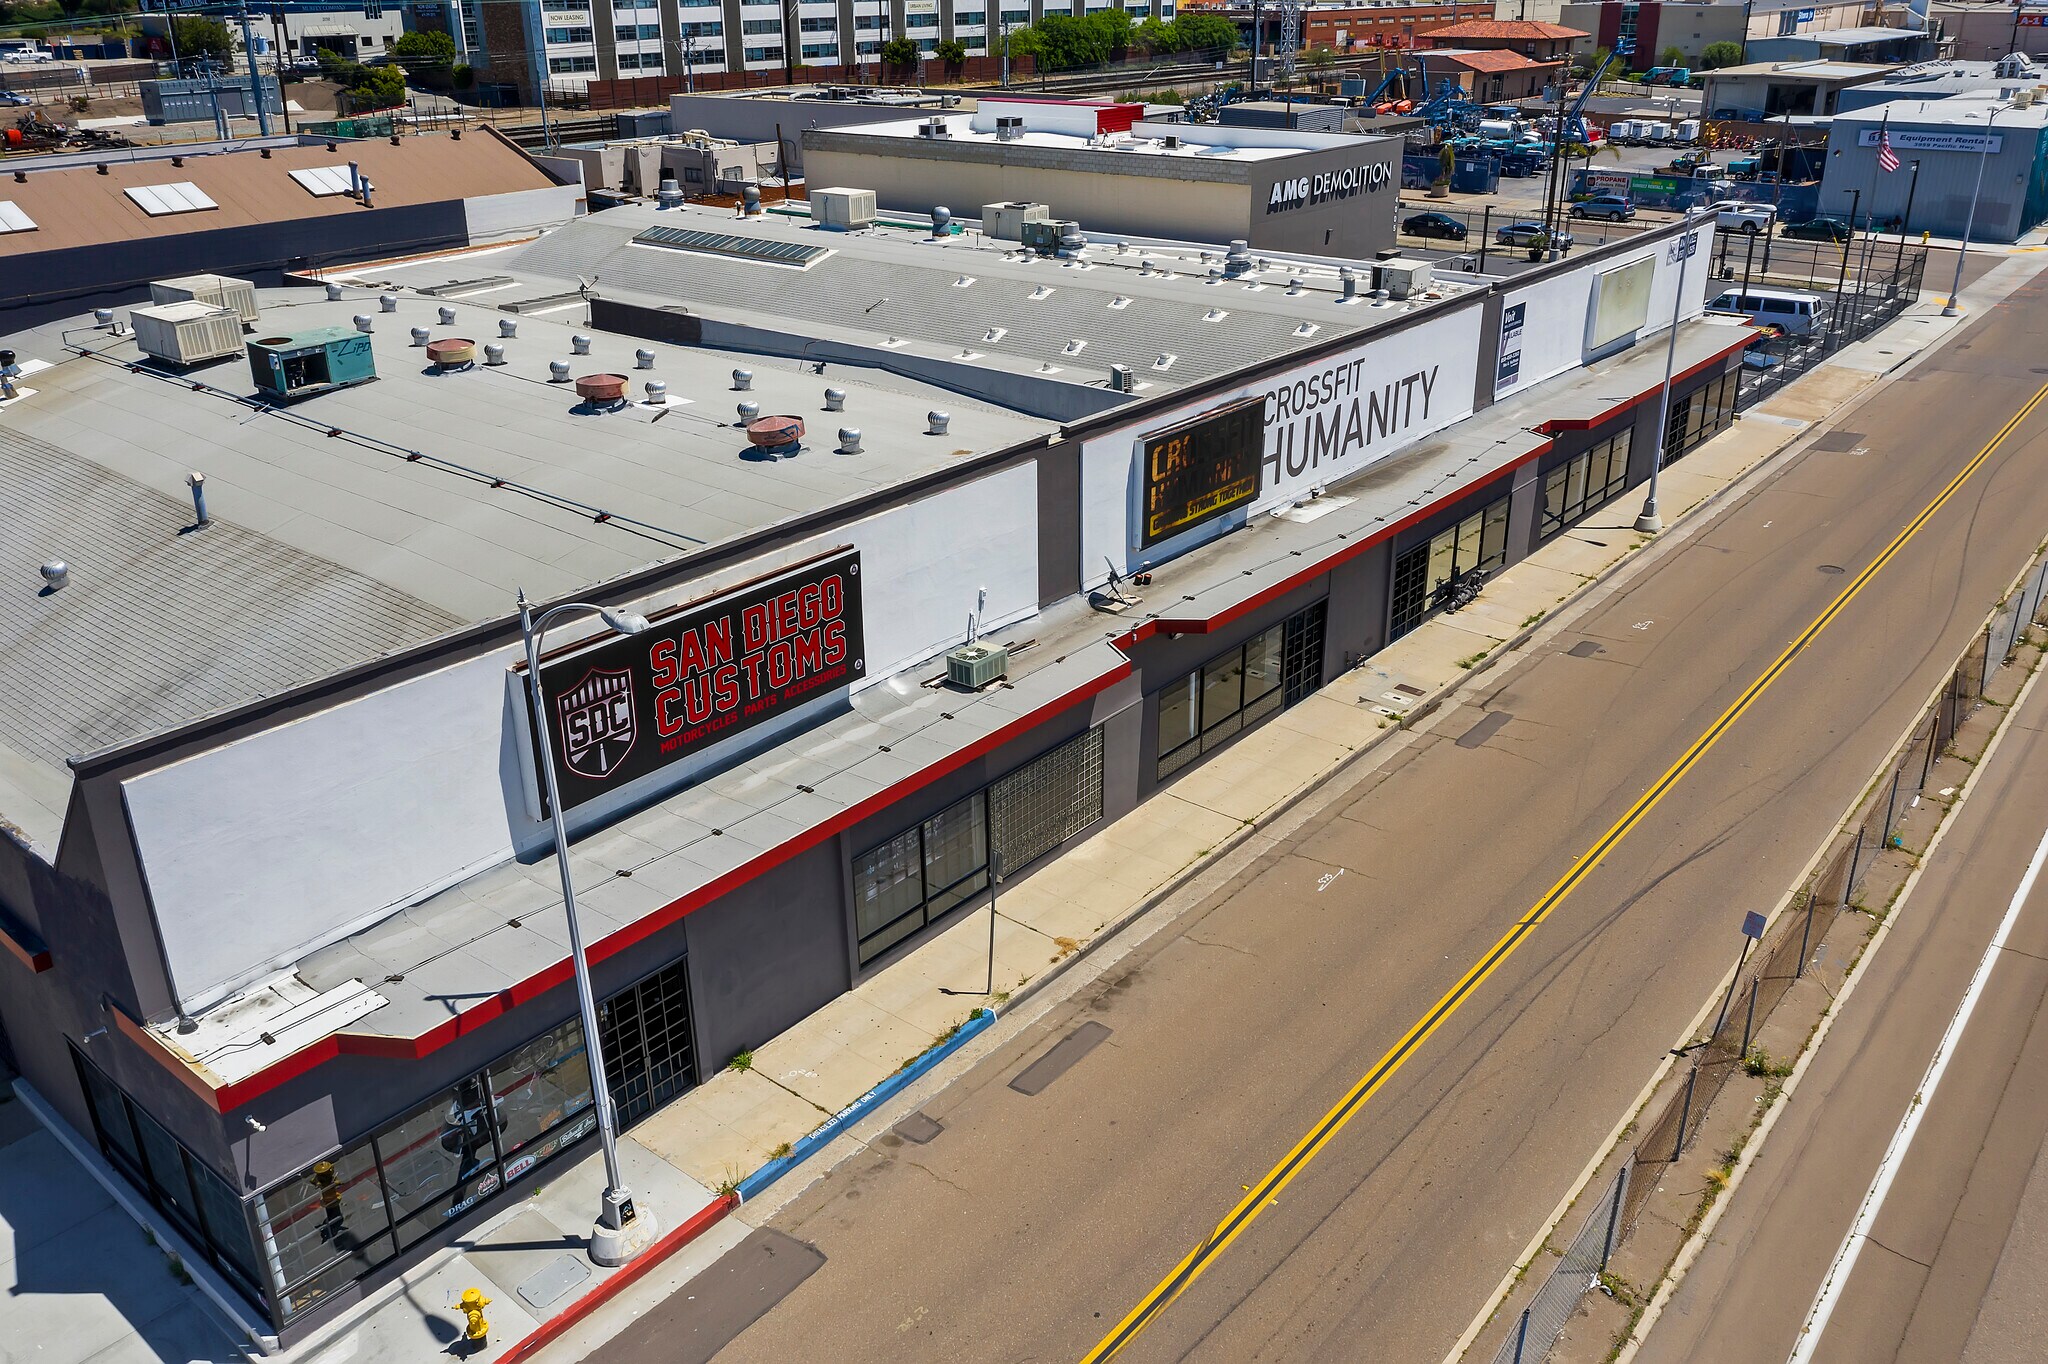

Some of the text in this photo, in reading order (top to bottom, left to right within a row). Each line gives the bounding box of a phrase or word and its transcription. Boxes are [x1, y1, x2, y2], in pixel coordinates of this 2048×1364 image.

[2020, 16, 2040, 25] A-1
[1899, 134, 1953, 143] Equipment
[1954, 136, 1994, 145] Rentas
[1270, 161, 1393, 205] AMG DEMOLITION
[1596, 176, 1627, 184] PROPANE
[1264, 357, 1366, 427] CROSSFIT
[1262, 364, 1440, 486] HUMANITY
[649, 574, 845, 691] SAN DIEGO
[654, 618, 848, 738] CUSTOMS
[567, 695, 630, 750] SDC
[660, 664, 848, 755] MOTORCYCLES PARTS ACCESSORIES
[809, 1090, 877, 1140] DISABLED PARKING ONLY
[506, 1159, 532, 1180] BELL
[447, 1196, 474, 1215] DRAG
